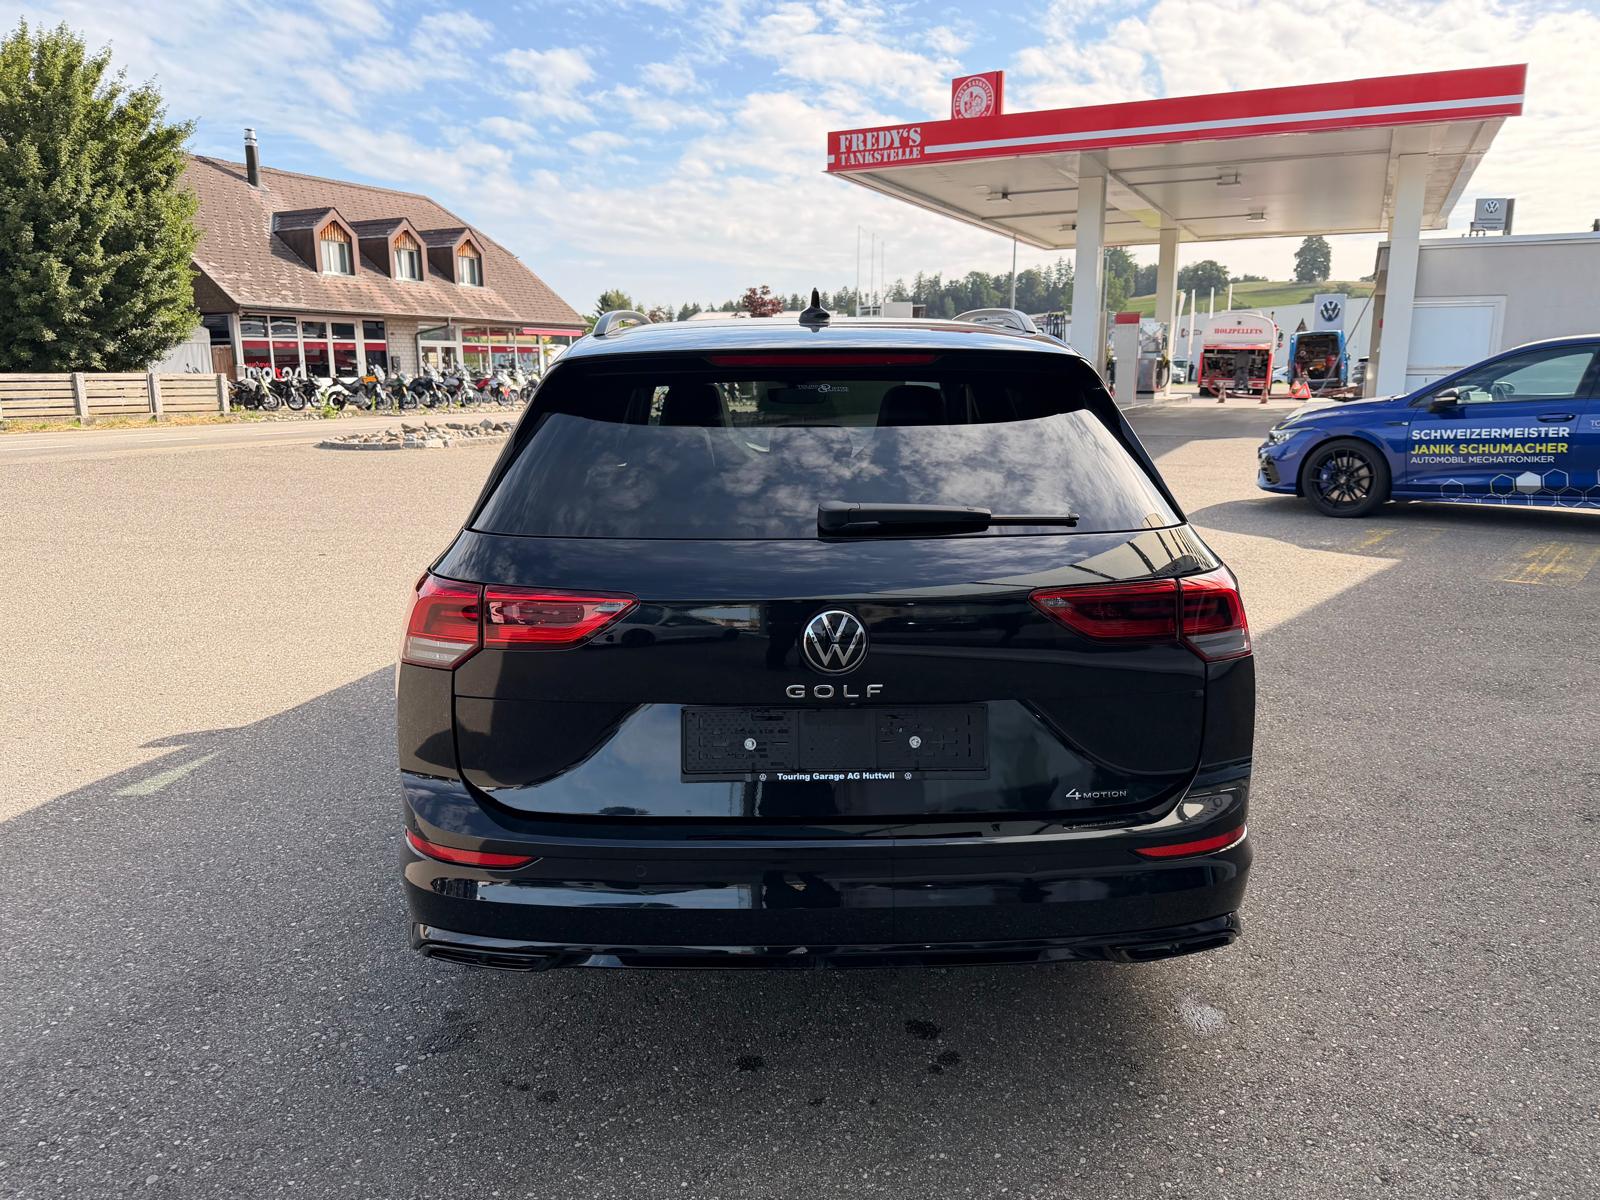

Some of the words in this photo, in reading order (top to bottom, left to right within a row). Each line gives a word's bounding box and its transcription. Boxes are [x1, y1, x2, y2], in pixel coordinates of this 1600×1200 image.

[839, 127, 921, 153] FREDY'S
[839, 146, 921, 166] TANKSTELLE
[1214, 327, 1264, 335] HOLZPELLETS
[1411, 426, 1570, 440] SCHWEIZERMEISTER
[1410, 444, 1455, 455] JANIK
[1459, 442, 1569, 454] SCHUMACHER
[1410, 456, 1466, 464] AUTOMOBIL
[1468, 455, 1555, 464] MECHATRONIKER
[785, 684, 884, 699] GOLF
[776, 772, 811, 782] Touring
[812, 772, 845, 782] Garage
[847, 772, 860, 780] AG
[862, 771, 895, 780] Huttwil
